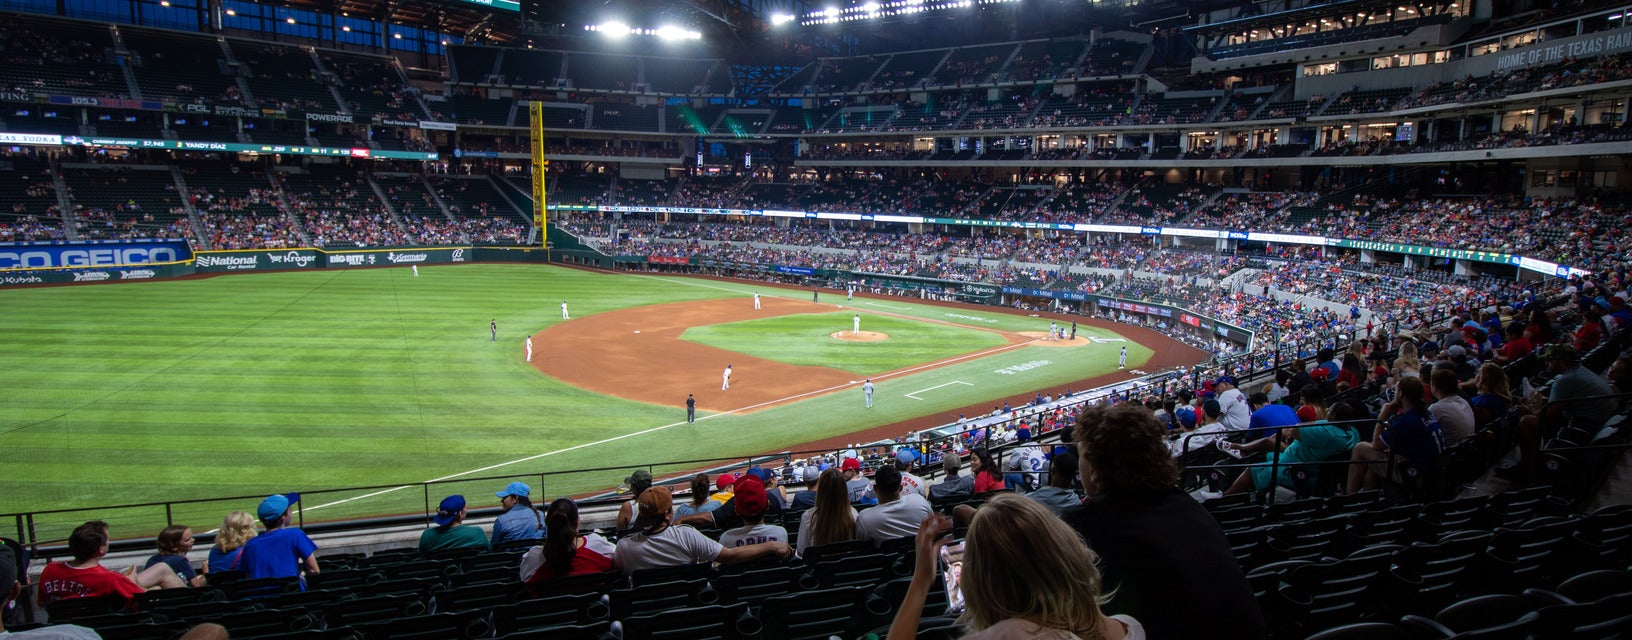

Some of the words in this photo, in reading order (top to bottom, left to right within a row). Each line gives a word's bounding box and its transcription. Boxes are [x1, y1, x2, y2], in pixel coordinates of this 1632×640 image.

[1497, 52, 1526, 70] HOME
[1528, 49, 1543, 64] OF
[1544, 44, 1565, 61] THE
[1567, 37, 1603, 57] TEXAS
[71, 97, 98, 106] 105.3
[306, 113, 353, 122] POWERADE
[60, 248, 176, 267] GEICO
[210, 255, 257, 266] National
[283, 251, 316, 267] Kroger
[1030, 457, 1043, 472] 2
